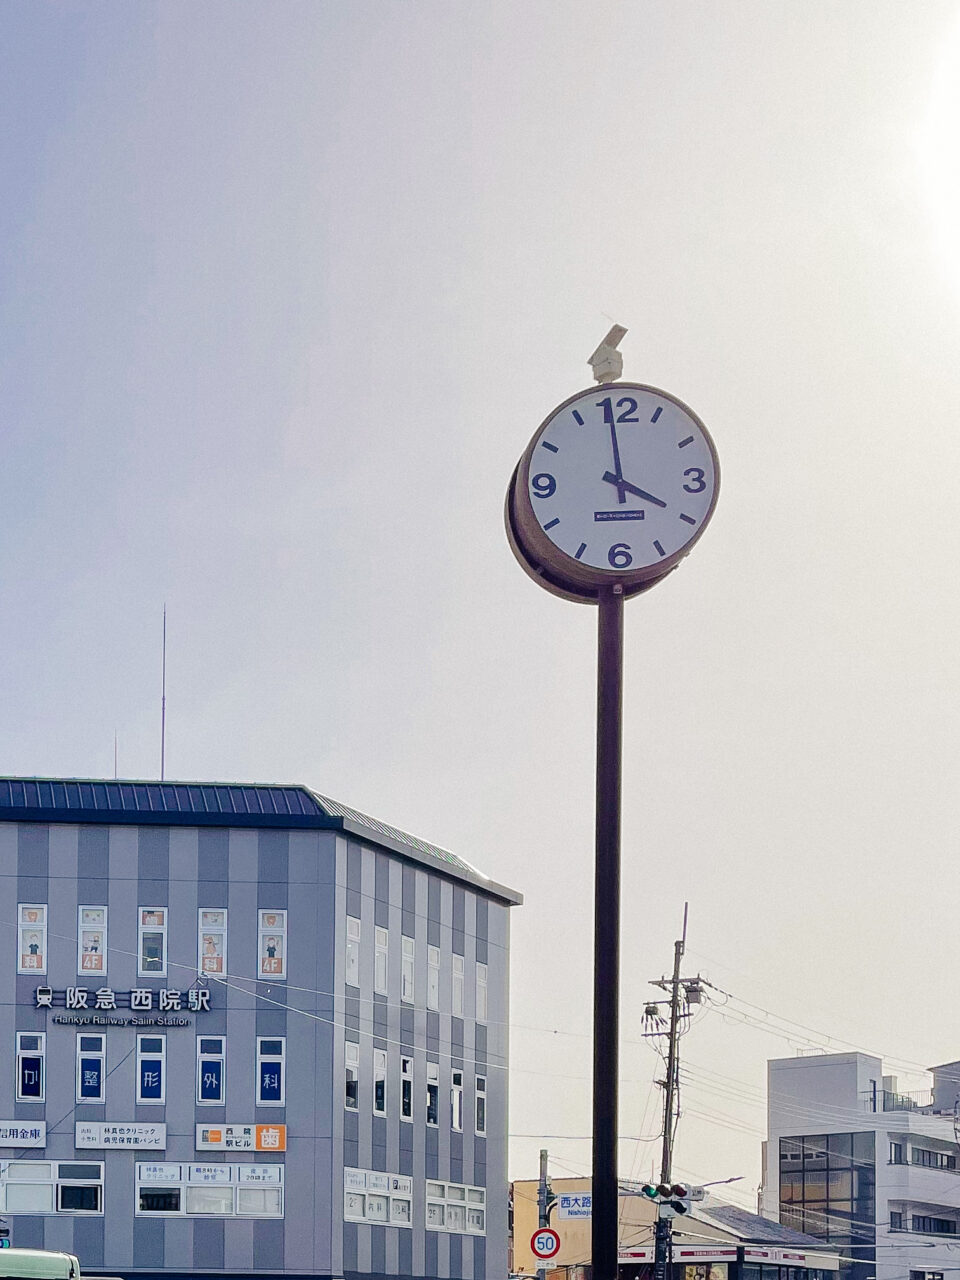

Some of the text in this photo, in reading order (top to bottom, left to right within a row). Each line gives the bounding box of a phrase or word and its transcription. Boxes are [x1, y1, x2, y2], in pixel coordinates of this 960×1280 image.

[596, 397, 639, 423] 12
[531, 473, 557, 499] 9
[682, 468, 707, 494] 3
[608, 543, 633, 568] 6
[83, 955, 98, 968] 4F
[263, 959, 278, 971] 4F
[55, 1015, 90, 1025] Hankyu
[93, 1016, 128, 1026] Railway
[157, 1017, 189, 1026] Station
[260, 1128, 280, 1148] 歯
[561, 1196, 591, 1208] 西大路
[537, 1237, 554, 1250] 50
